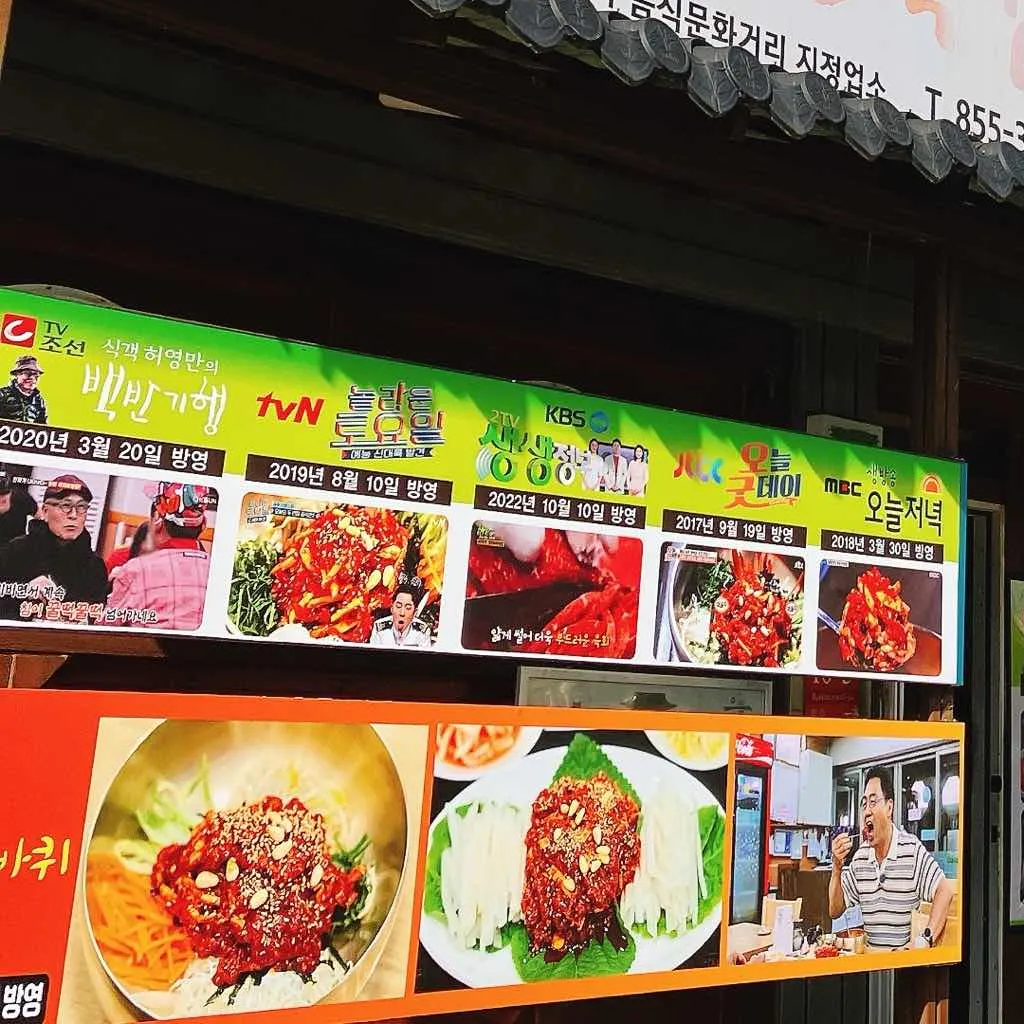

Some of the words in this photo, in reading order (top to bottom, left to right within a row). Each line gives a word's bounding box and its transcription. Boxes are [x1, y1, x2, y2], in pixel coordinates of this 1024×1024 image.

[796, 43, 886, 98] 지정업소
[43, 320, 69, 336] TV
[38, 335, 87, 358] 조선
[101, 338, 140, 362] 식객
[143, 346, 221, 375] 허영만의
[80, 360, 228, 436] 백반기행
[256, 391, 325, 426] tvN
[545, 404, 586, 428] KBS
[330, 409, 446, 448] 토요일
[0, 427, 68, 454] 2020년
[78, 436, 111, 459] 3월
[118, 442, 162, 465] 20일
[171, 448, 209, 471] 방영
[738, 441, 792, 473] 오늘
[269, 462, 325, 487] 2019년
[331, 470, 359, 492] 8월
[366, 475, 400, 497] 10일
[406, 480, 438, 502] 방영
[723, 472, 802, 509] 굿데이
[866, 463, 897, 488] 생방송
[487, 490, 536, 514] 2022년
[542, 498, 571, 518] 10월
[577, 502, 606, 522] 10일
[611, 507, 637, 526] 방영
[676, 514, 714, 533] 2017년
[719, 520, 738, 537] 9월
[743, 523, 766, 541] 19일
[771, 526, 794, 545] 방영
[831, 534, 865, 553] 2018년
[869, 539, 886, 556] 3월
[889, 541, 911, 558] 30일
[2, 981, 44, 1020] 방영
